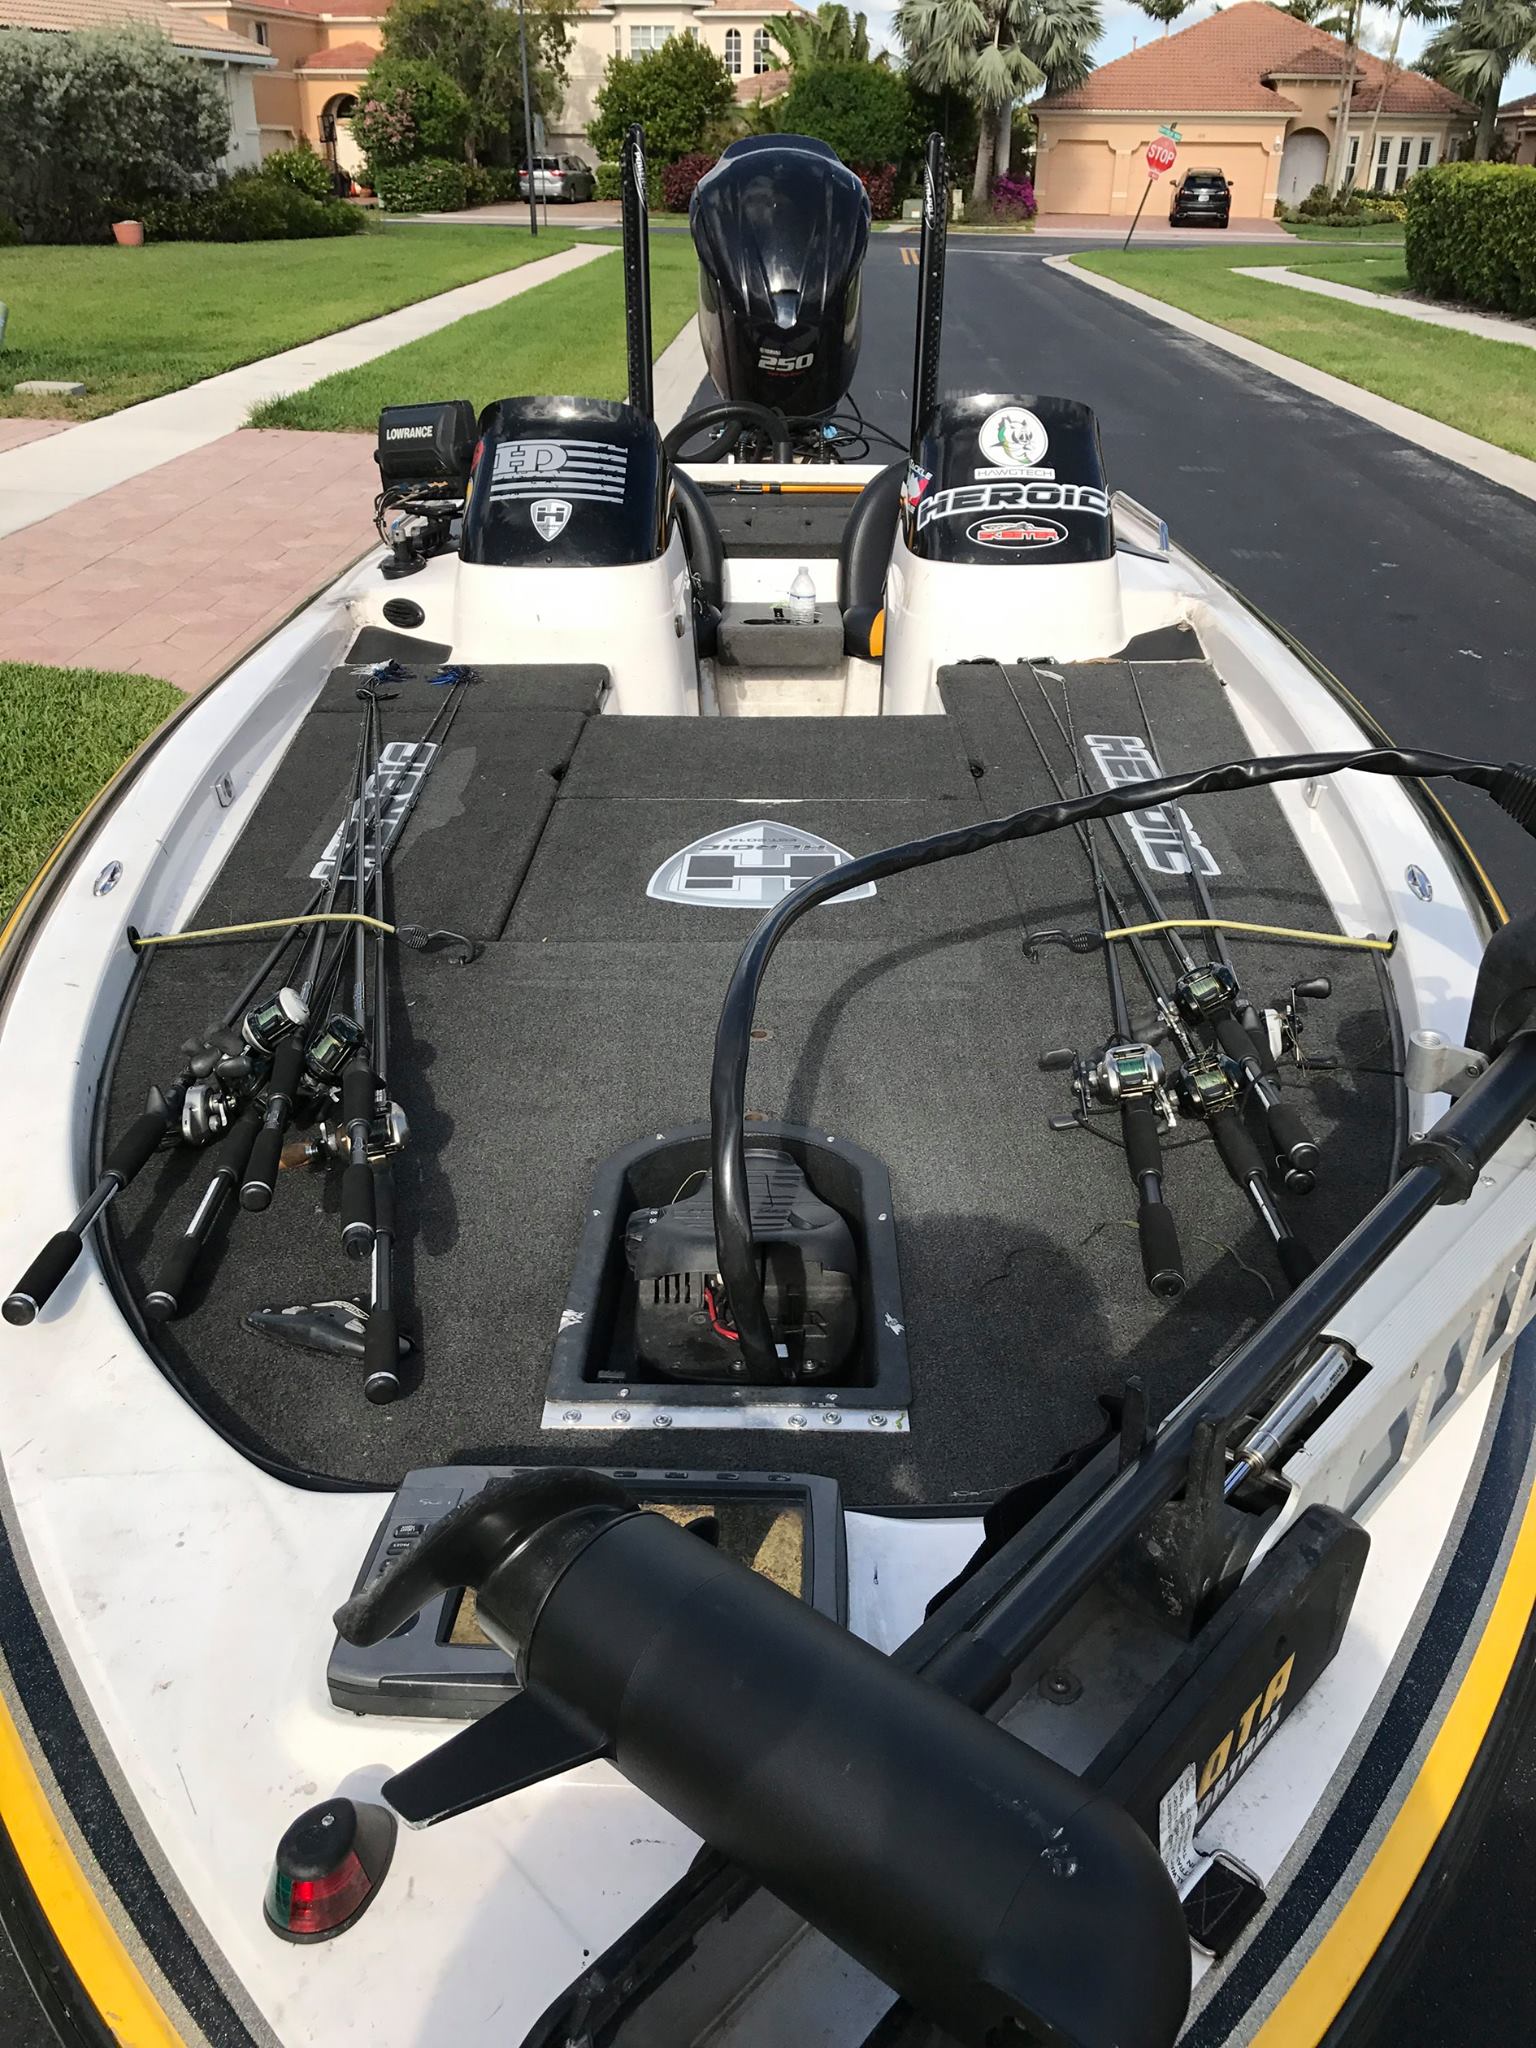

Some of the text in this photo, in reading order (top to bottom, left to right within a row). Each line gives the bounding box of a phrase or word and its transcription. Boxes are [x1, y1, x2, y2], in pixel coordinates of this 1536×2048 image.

[1148, 144, 1175, 165] STOP
[758, 353, 814, 371] 250
[386, 425, 433, 441] LOWRANCE
[917, 482, 1112, 531] HEROIC
[1084, 735, 1222, 875] HEOIC
[1197, 1651, 1296, 1800] OTA
[1197, 1702, 1282, 1824] ORTREX
